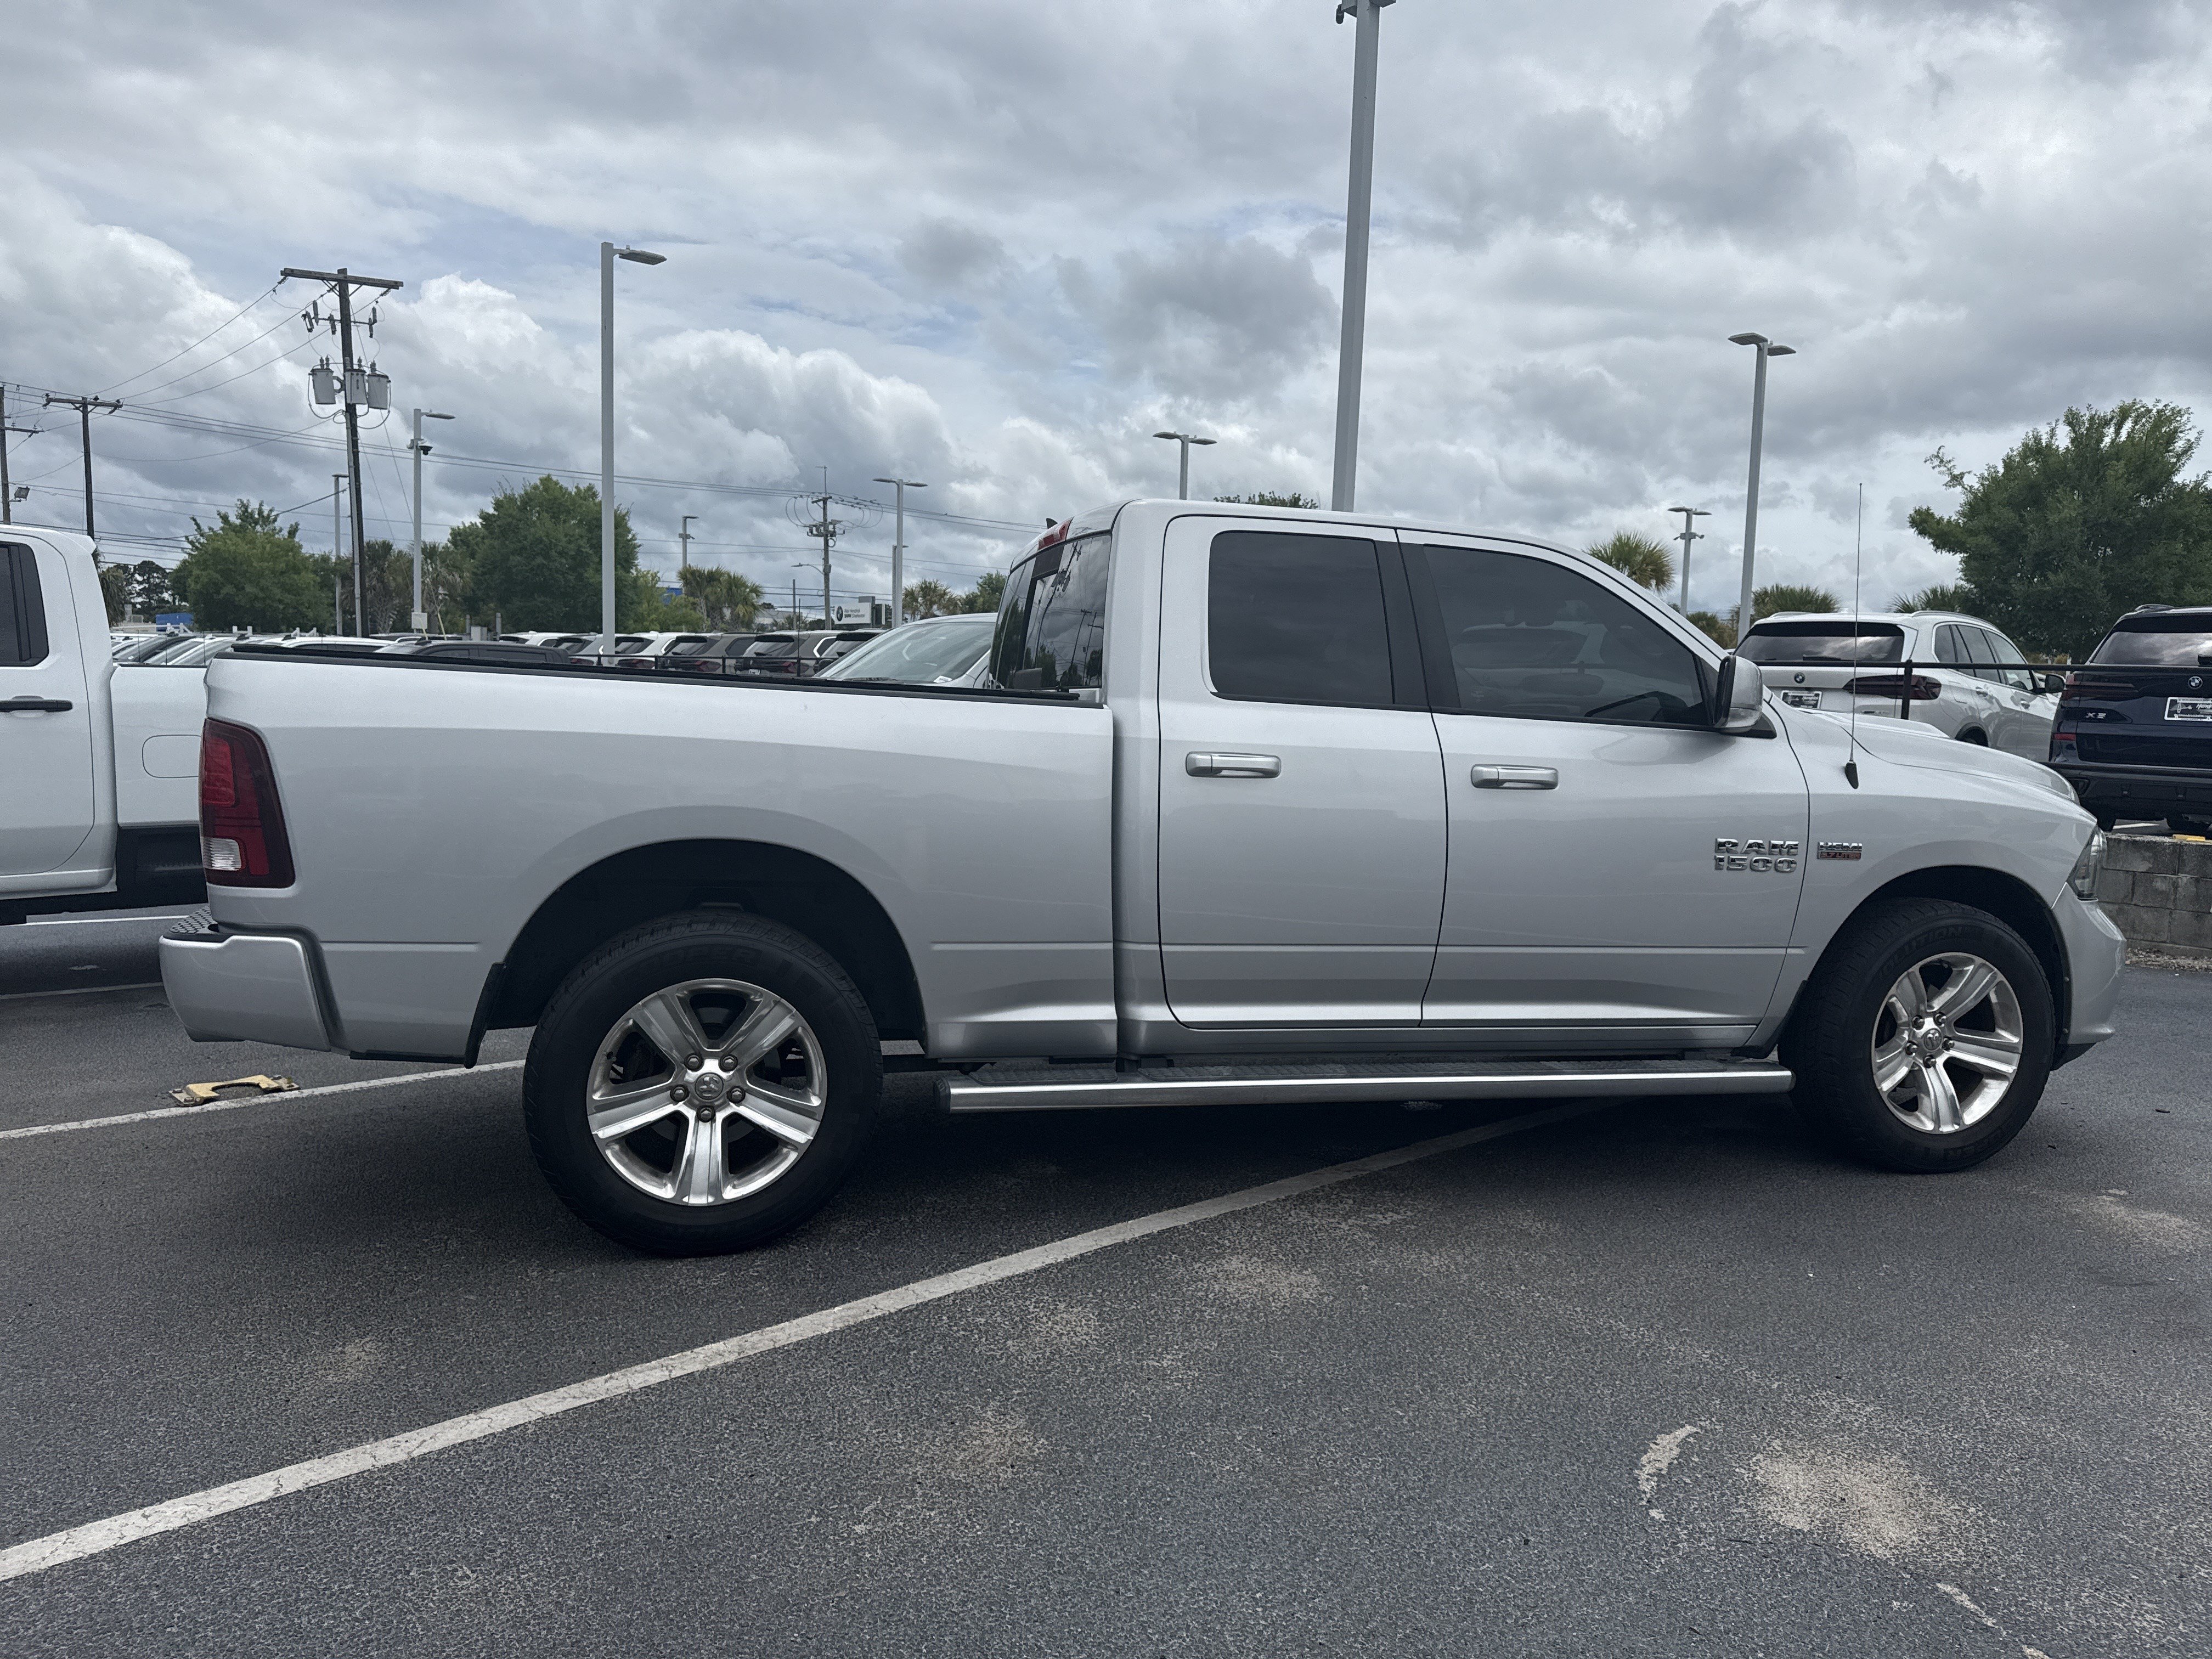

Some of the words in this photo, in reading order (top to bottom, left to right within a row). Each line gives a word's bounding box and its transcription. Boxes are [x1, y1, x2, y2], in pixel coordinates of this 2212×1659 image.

[1715, 838, 1799, 855] RAM
[1818, 842, 1863, 851] HEMI
[1714, 855, 1797, 872] 1500
